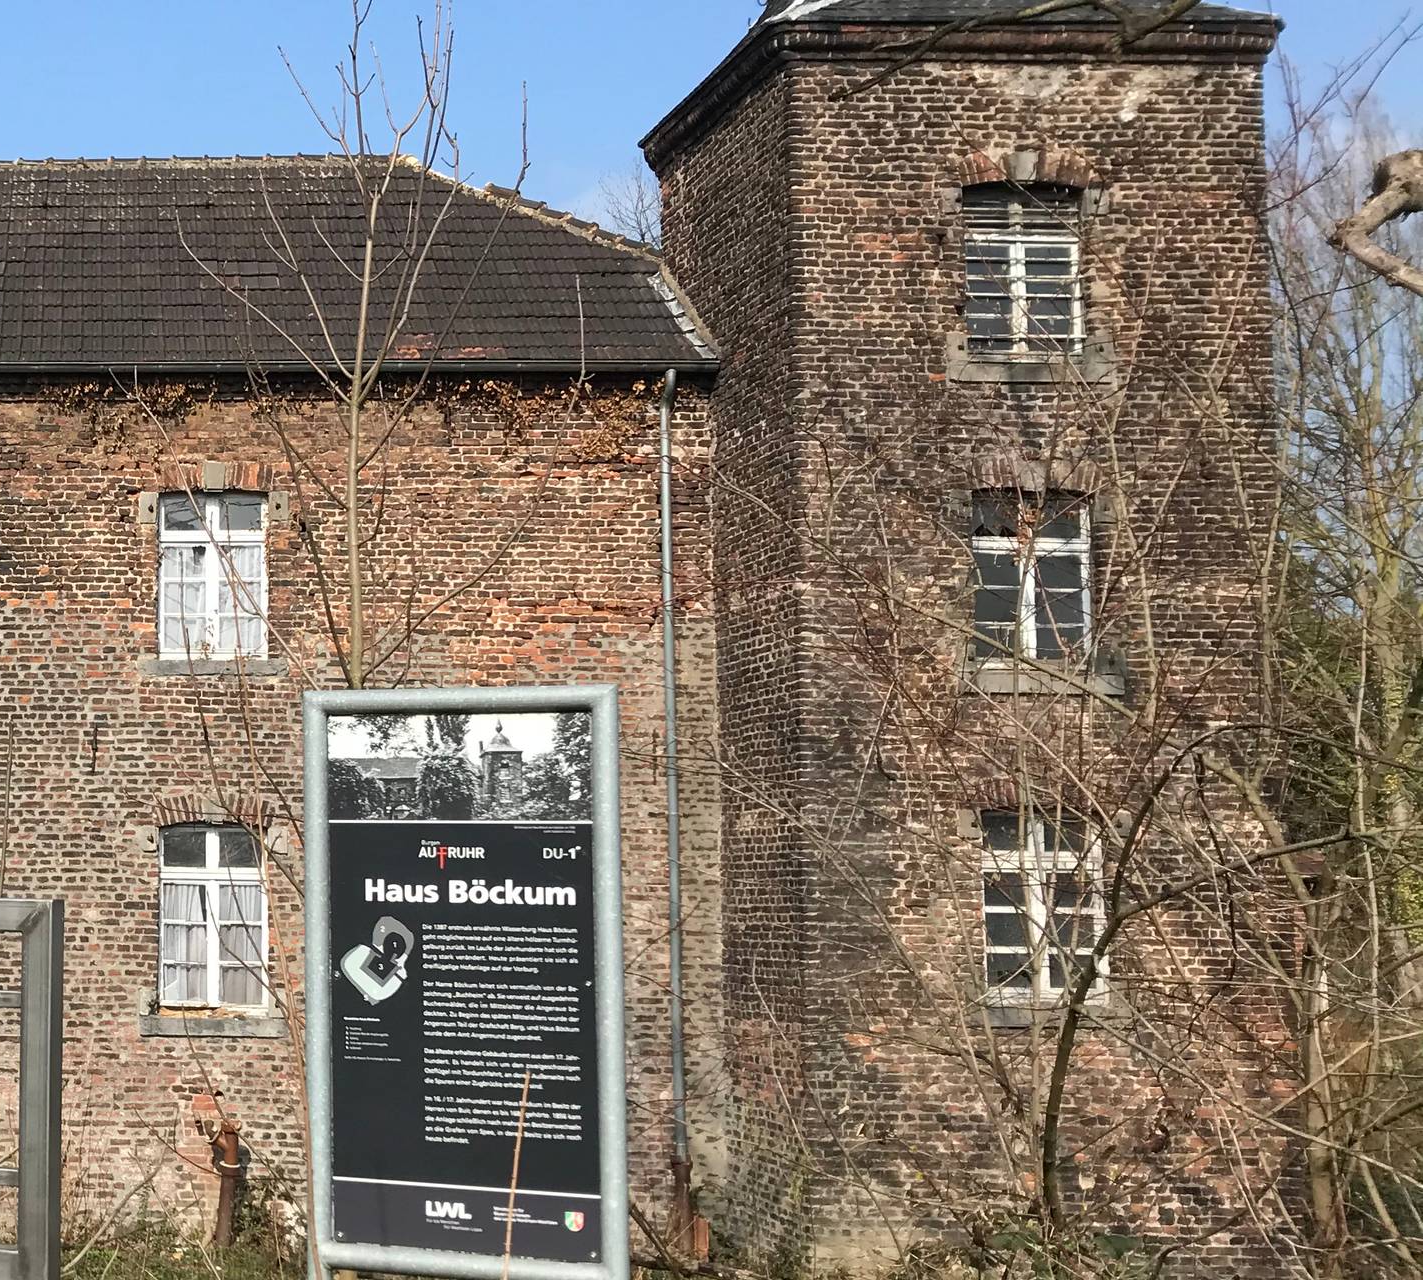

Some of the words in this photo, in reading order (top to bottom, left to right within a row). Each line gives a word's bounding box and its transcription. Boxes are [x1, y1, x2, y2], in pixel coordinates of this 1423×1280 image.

[364, 878, 438, 904] Haus
[448, 879, 576, 906] Böckum
[425, 1200, 472, 1220] LWL
